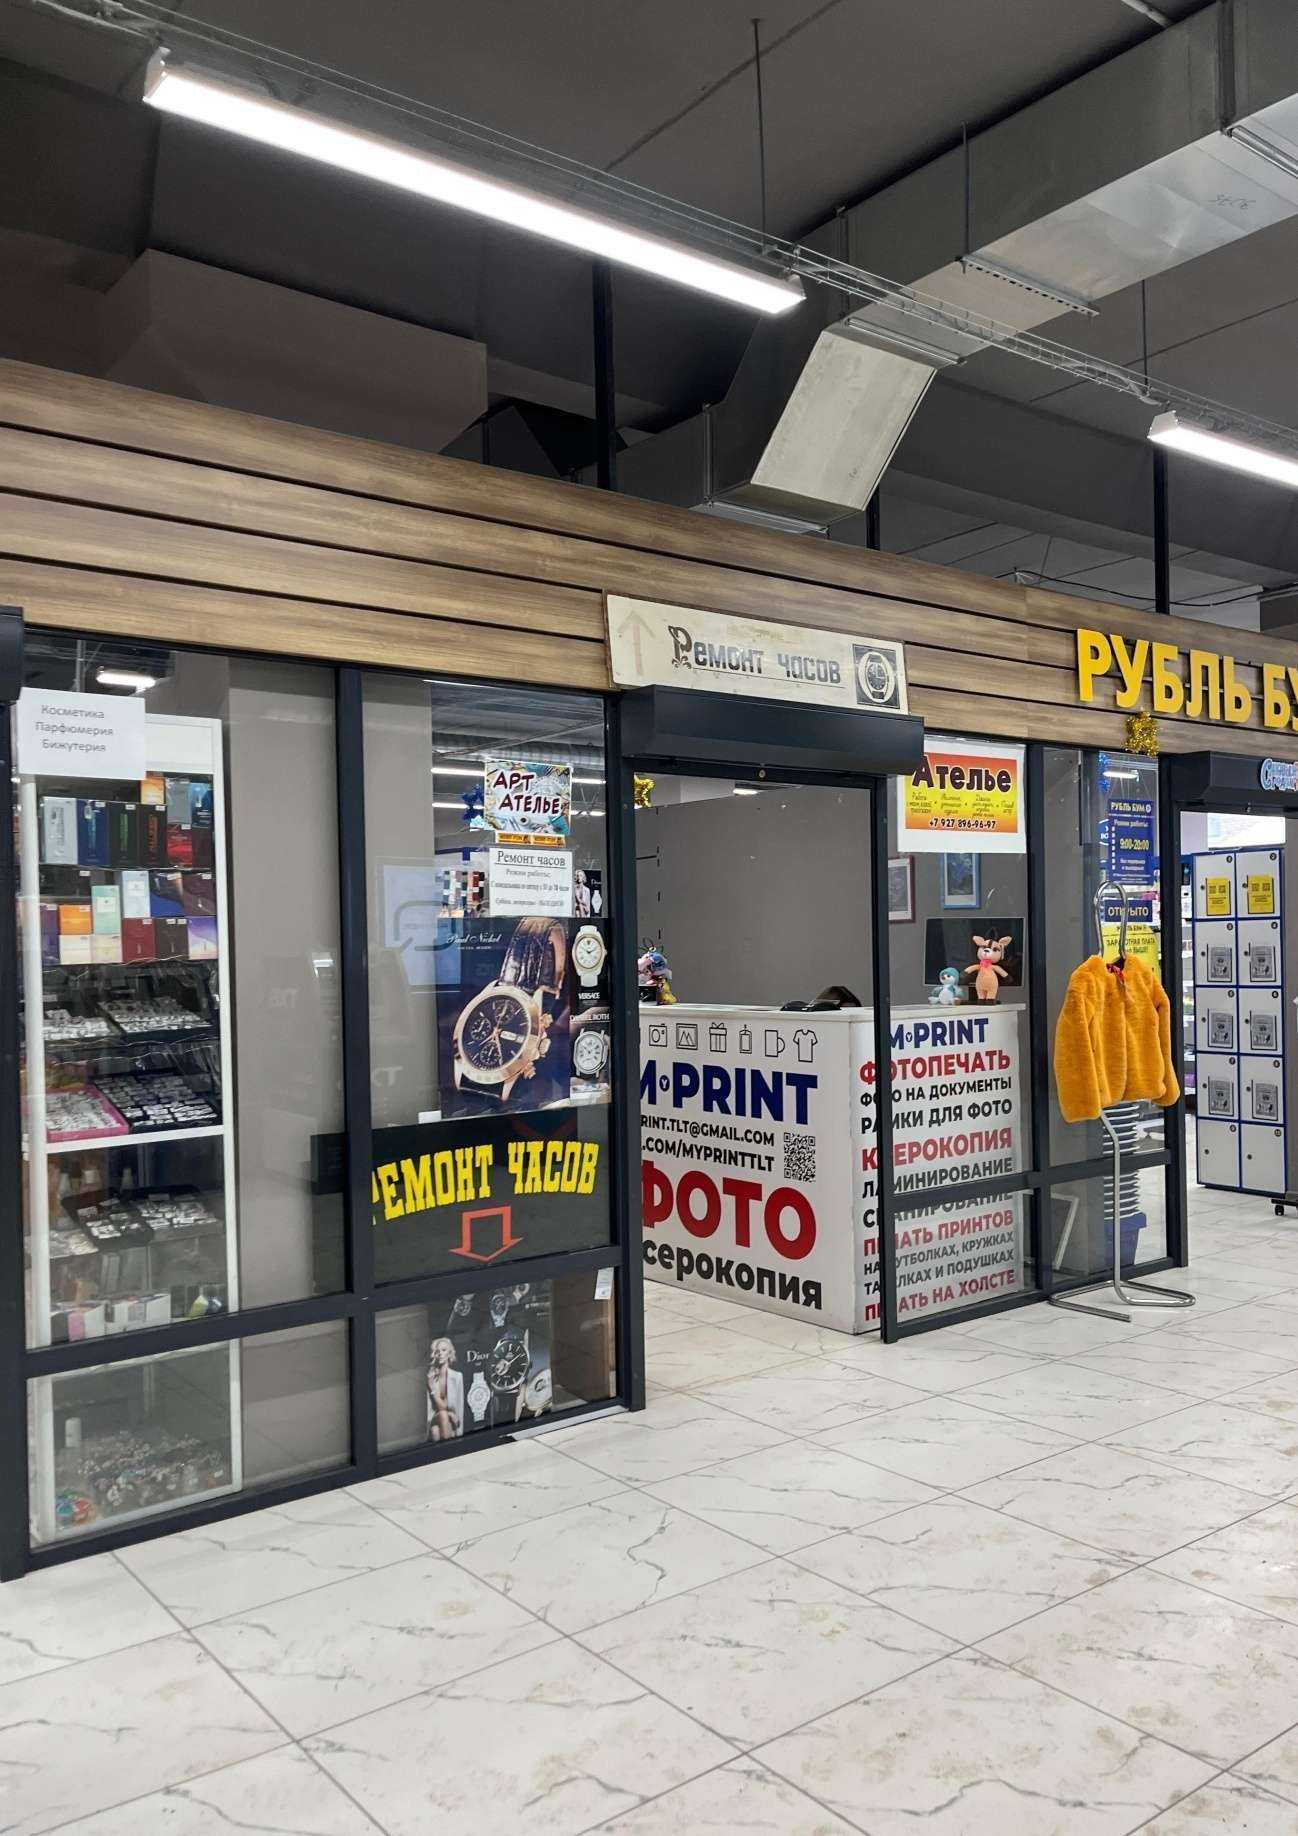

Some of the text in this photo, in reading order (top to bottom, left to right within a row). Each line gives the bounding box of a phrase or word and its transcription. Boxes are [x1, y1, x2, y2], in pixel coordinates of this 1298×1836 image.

[668, 625, 841, 684] Ремонт часов
[1077, 628, 1252, 723] РУБЛЬ
[41, 705, 105, 719] Косметика
[35, 722, 114, 736] Парфюмерия
[42, 740, 107, 752] Бижутерия
[493, 771, 534, 792] АРТ
[912, 755, 1011, 792] Ателье
[498, 794, 560, 814] АТЕЛЬЕ
[941, 819, 955, 827] 927
[498, 851, 566, 866] Ремонт часов
[1107, 906, 1149, 917] ОТЫТО
[906, 1087, 925, 1101] НА
[929, 1077, 1011, 1101] ДОКУМЕНТЫ
[928, 1105, 963, 1128] ДЛЯ
[968, 1099, 1012, 1120] ФОТО
[862, 1127, 1011, 1172] КЕРОКОПИЯ
[372, 1141, 599, 1225] ЕМОНТ ЧАСОВ
[864, 1209, 1013, 1257] ПАТЬ ПРИНТОВ
[962, 1231, 1014, 1253] КРУЖКАХ
[935, 1266, 944, 1279] И
[947, 1249, 1014, 1276] ПОДУШКАХ
[865, 1270, 1015, 1321] ПАТЬ НА ХОЛСТЕ
[467, 1350, 490, 1362] Dior
